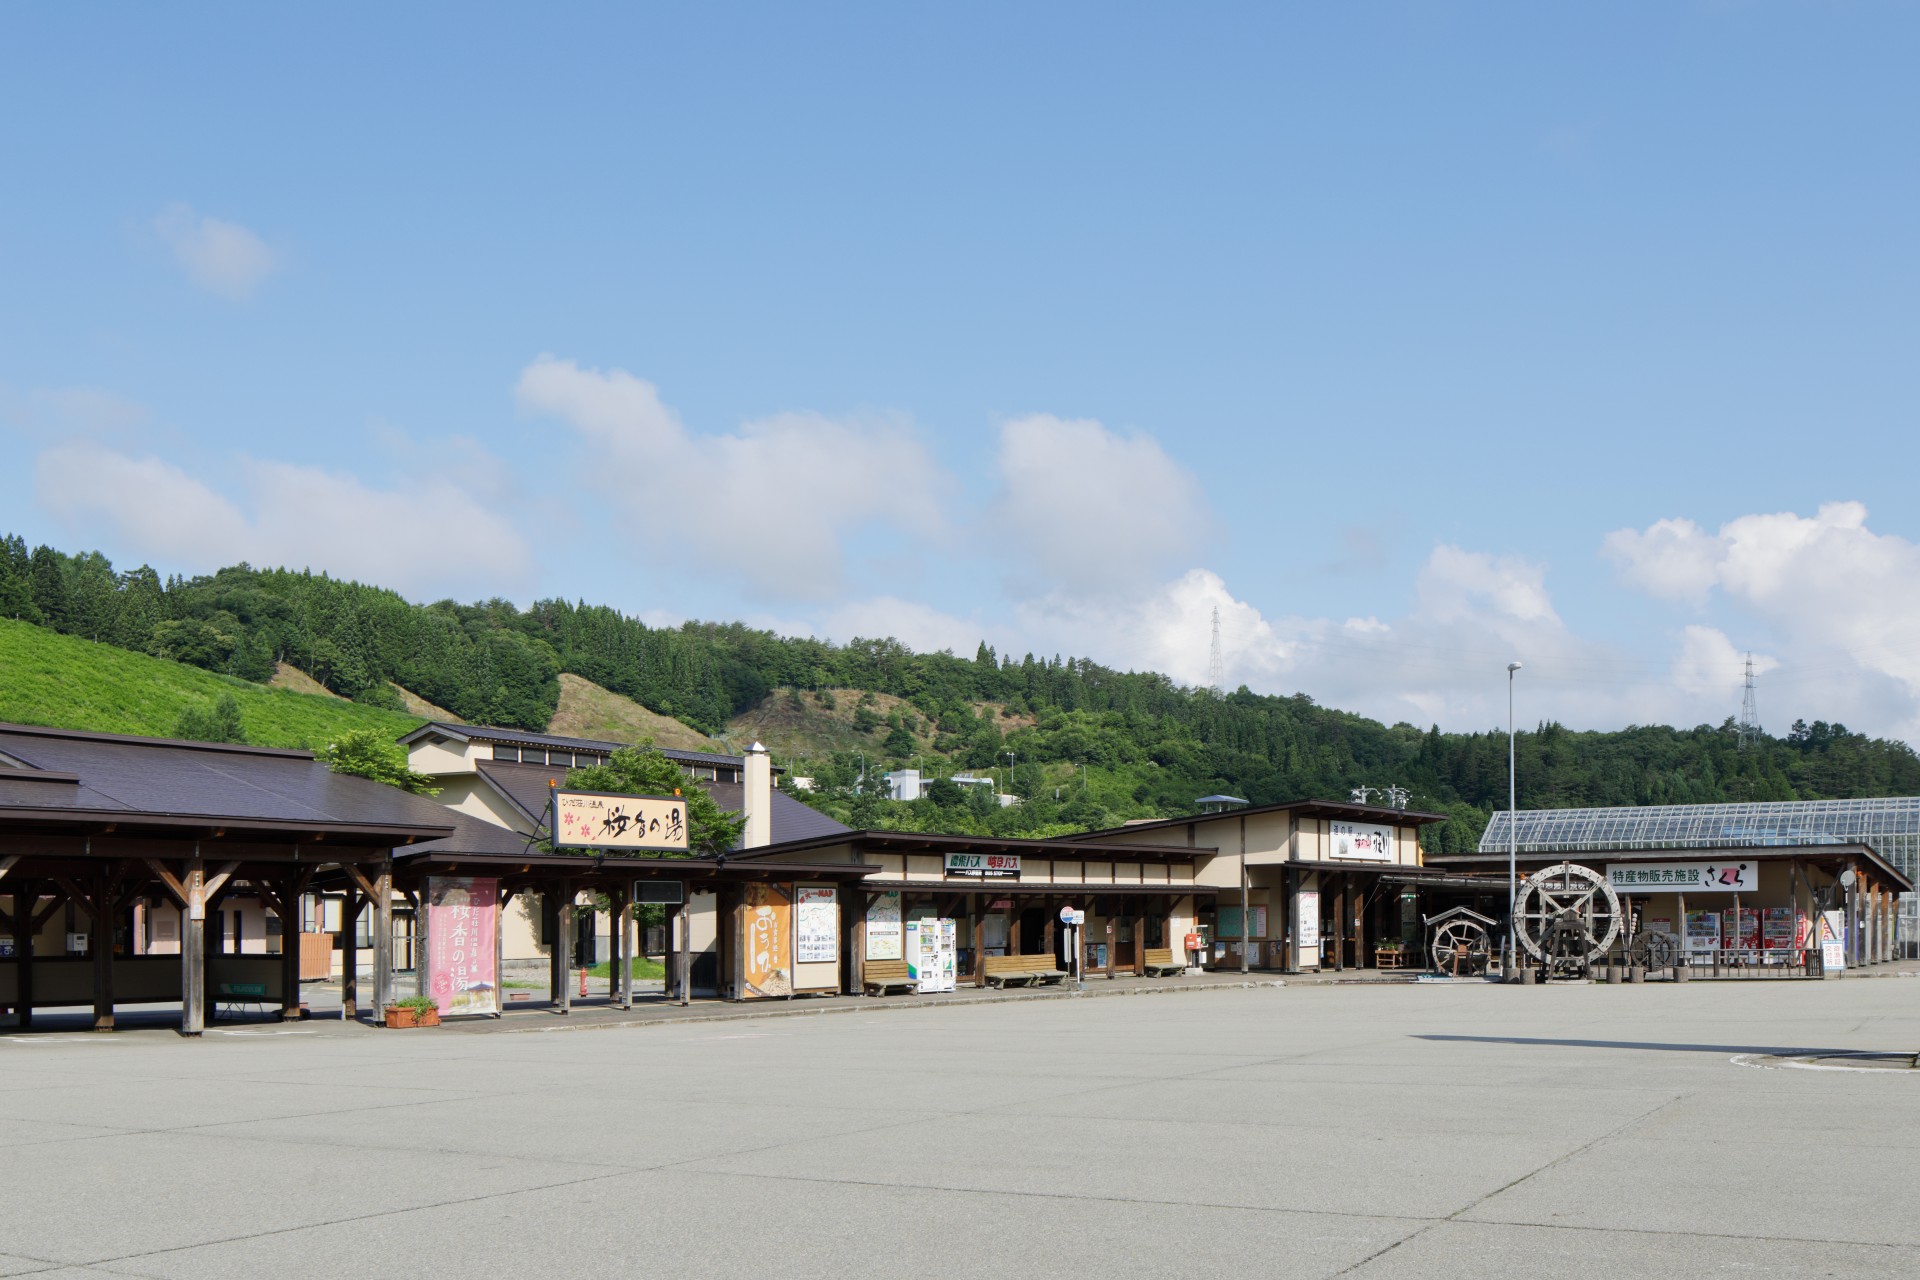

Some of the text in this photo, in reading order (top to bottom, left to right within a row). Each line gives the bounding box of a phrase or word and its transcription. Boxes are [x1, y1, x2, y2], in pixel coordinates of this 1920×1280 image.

[598, 805, 684, 842] 桜香の湯
[1333, 825, 1353, 836] 道の駅
[950, 855, 1018, 868] 濃飛バス 岐阜バス
[1612, 863, 1747, 887] 特産物販売施設 さくら
[449, 904, 471, 992] 桜香の湯
